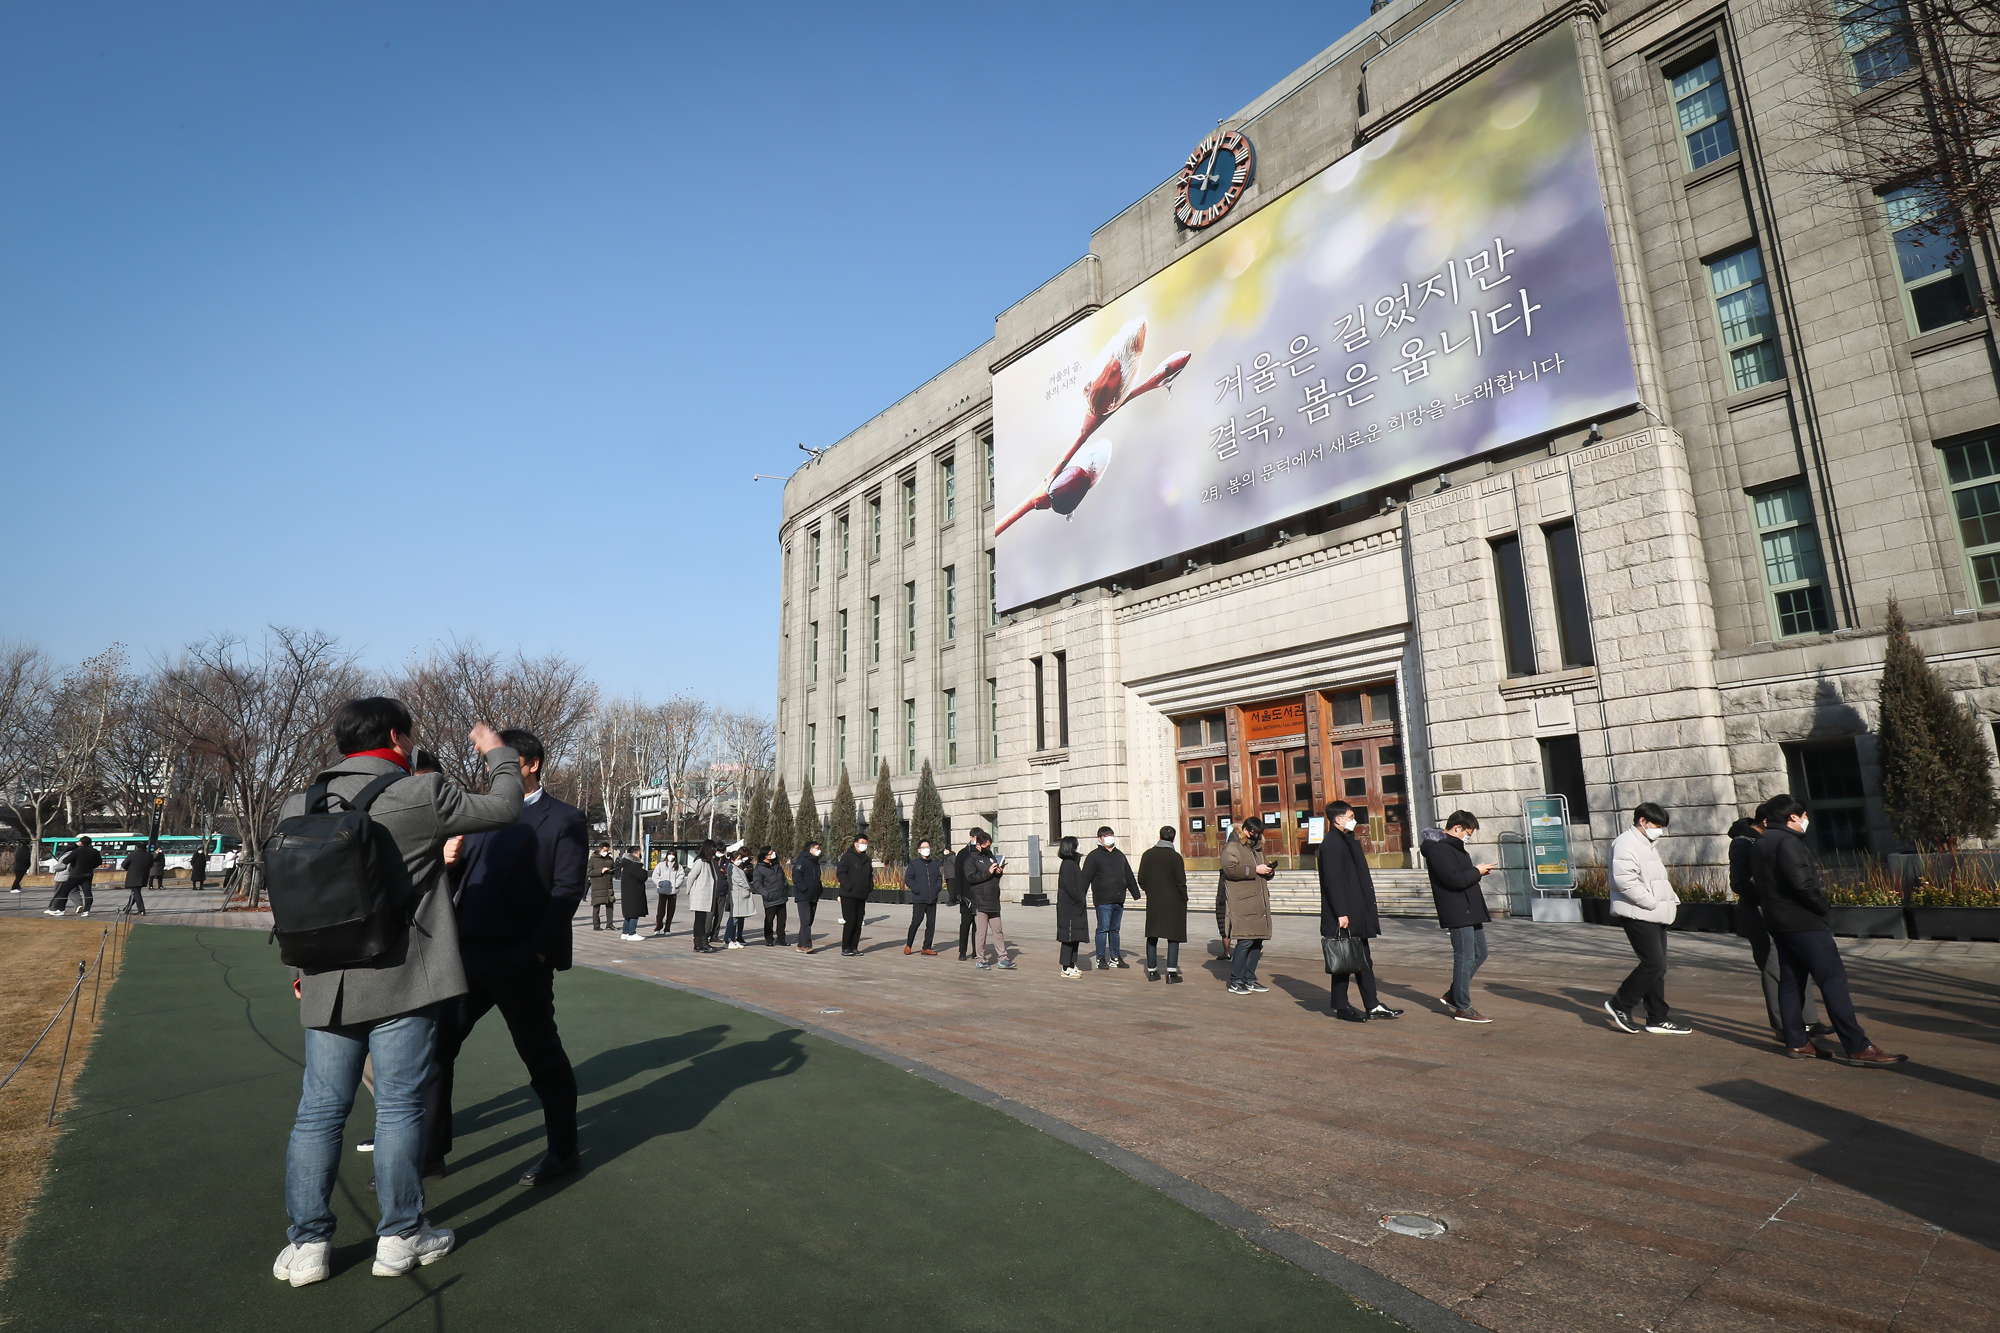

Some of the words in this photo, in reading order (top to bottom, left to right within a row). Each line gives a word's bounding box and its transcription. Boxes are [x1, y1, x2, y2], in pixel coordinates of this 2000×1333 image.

[1215, 335, 1319, 404] 겨울은
[1332, 237, 1515, 353] 길었지만
[1045, 385, 1059, 400] 봄의
[1062, 375, 1077, 389] 시작
[1049, 366, 1069, 384] 겨울의
[1209, 405, 1285, 461] 결국,
[1297, 363, 1379, 425] 봄은
[1391, 288, 1542, 386] 옵니다
[1201, 485, 1223, 503] 2月,
[1227, 469, 1256, 495] 봄의
[1260, 443, 1324, 482] 문턱에서
[1329, 423, 1382, 454] 새로운
[1387, 399, 1446, 433] 희망을
[1452, 352, 1565, 410] 노래합니다
[1251, 705, 1304, 722] 서울도서관
